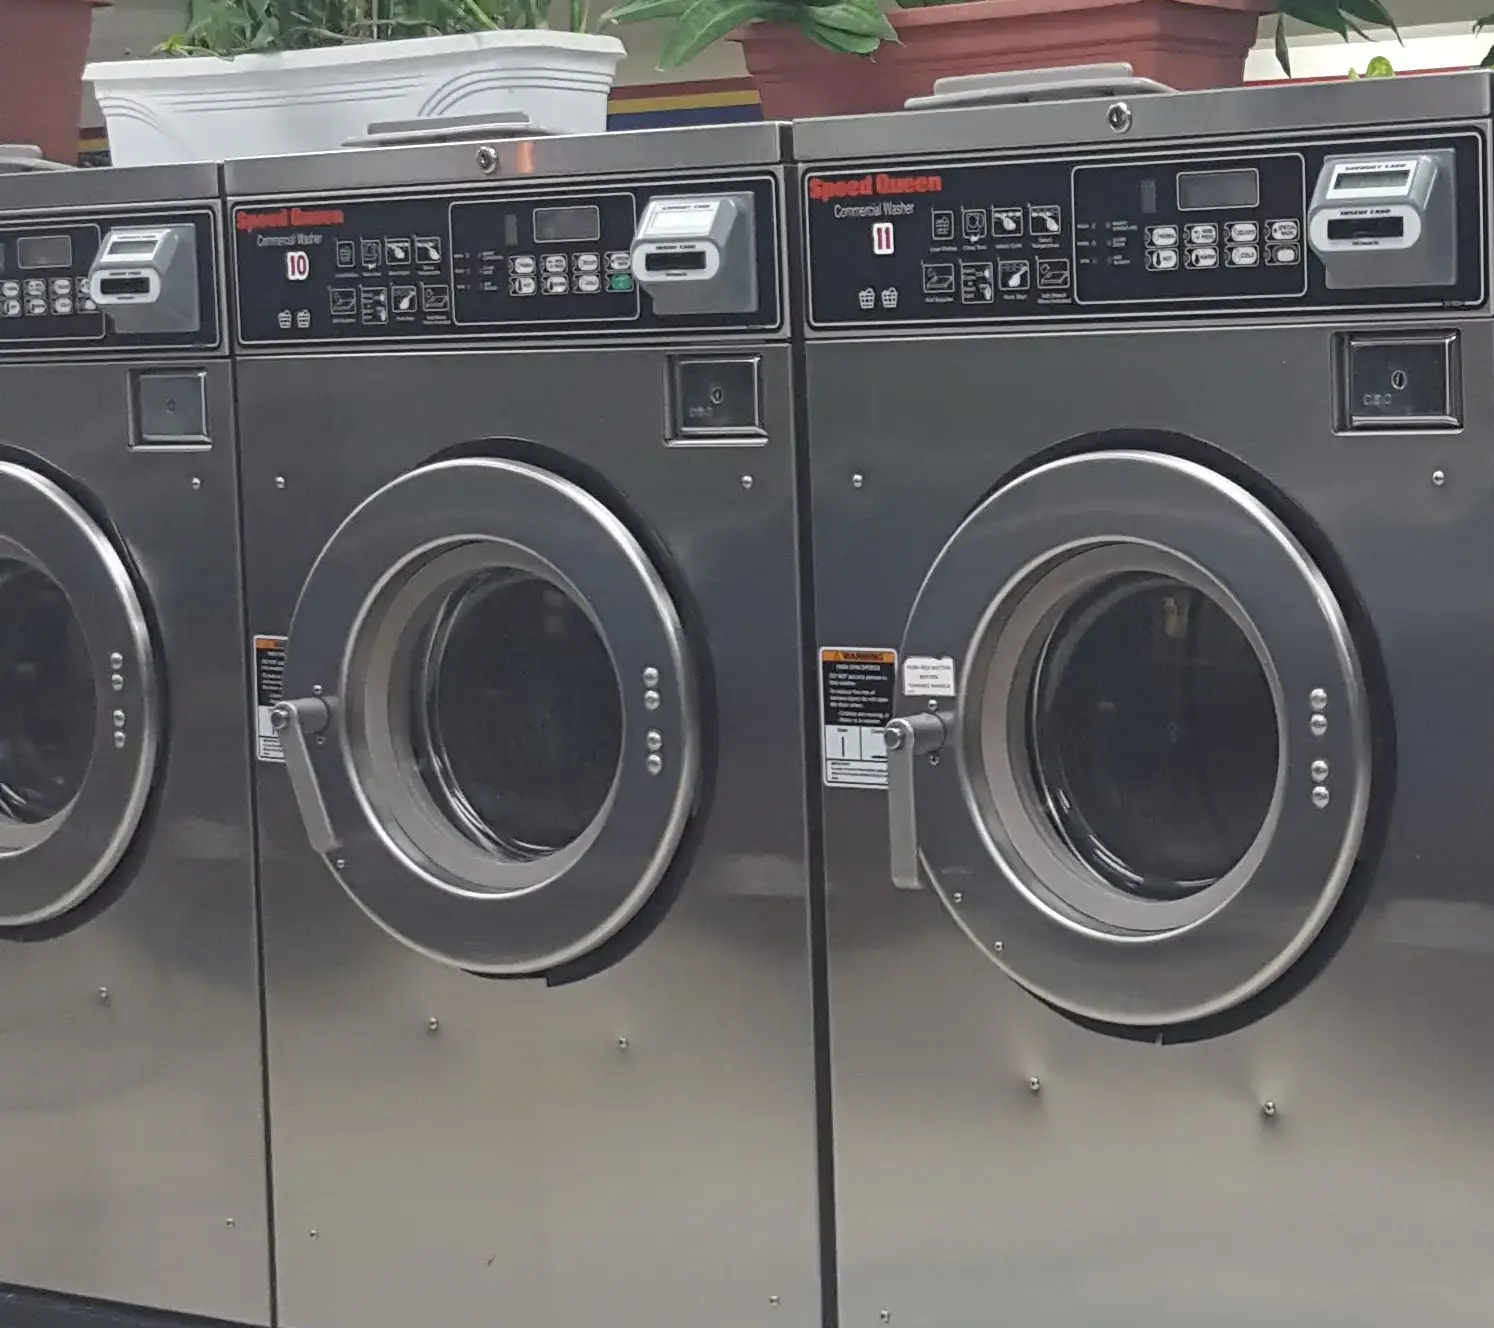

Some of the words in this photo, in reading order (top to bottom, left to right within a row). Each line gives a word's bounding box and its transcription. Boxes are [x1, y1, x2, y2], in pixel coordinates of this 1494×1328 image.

[809, 176, 874, 203] Speed
[876, 174, 943, 194] Queen
[834, 203, 883, 219] Commercial
[883, 202, 915, 216] Washer
[876, 227, 892, 251] 11
[289, 254, 308, 278] 10
